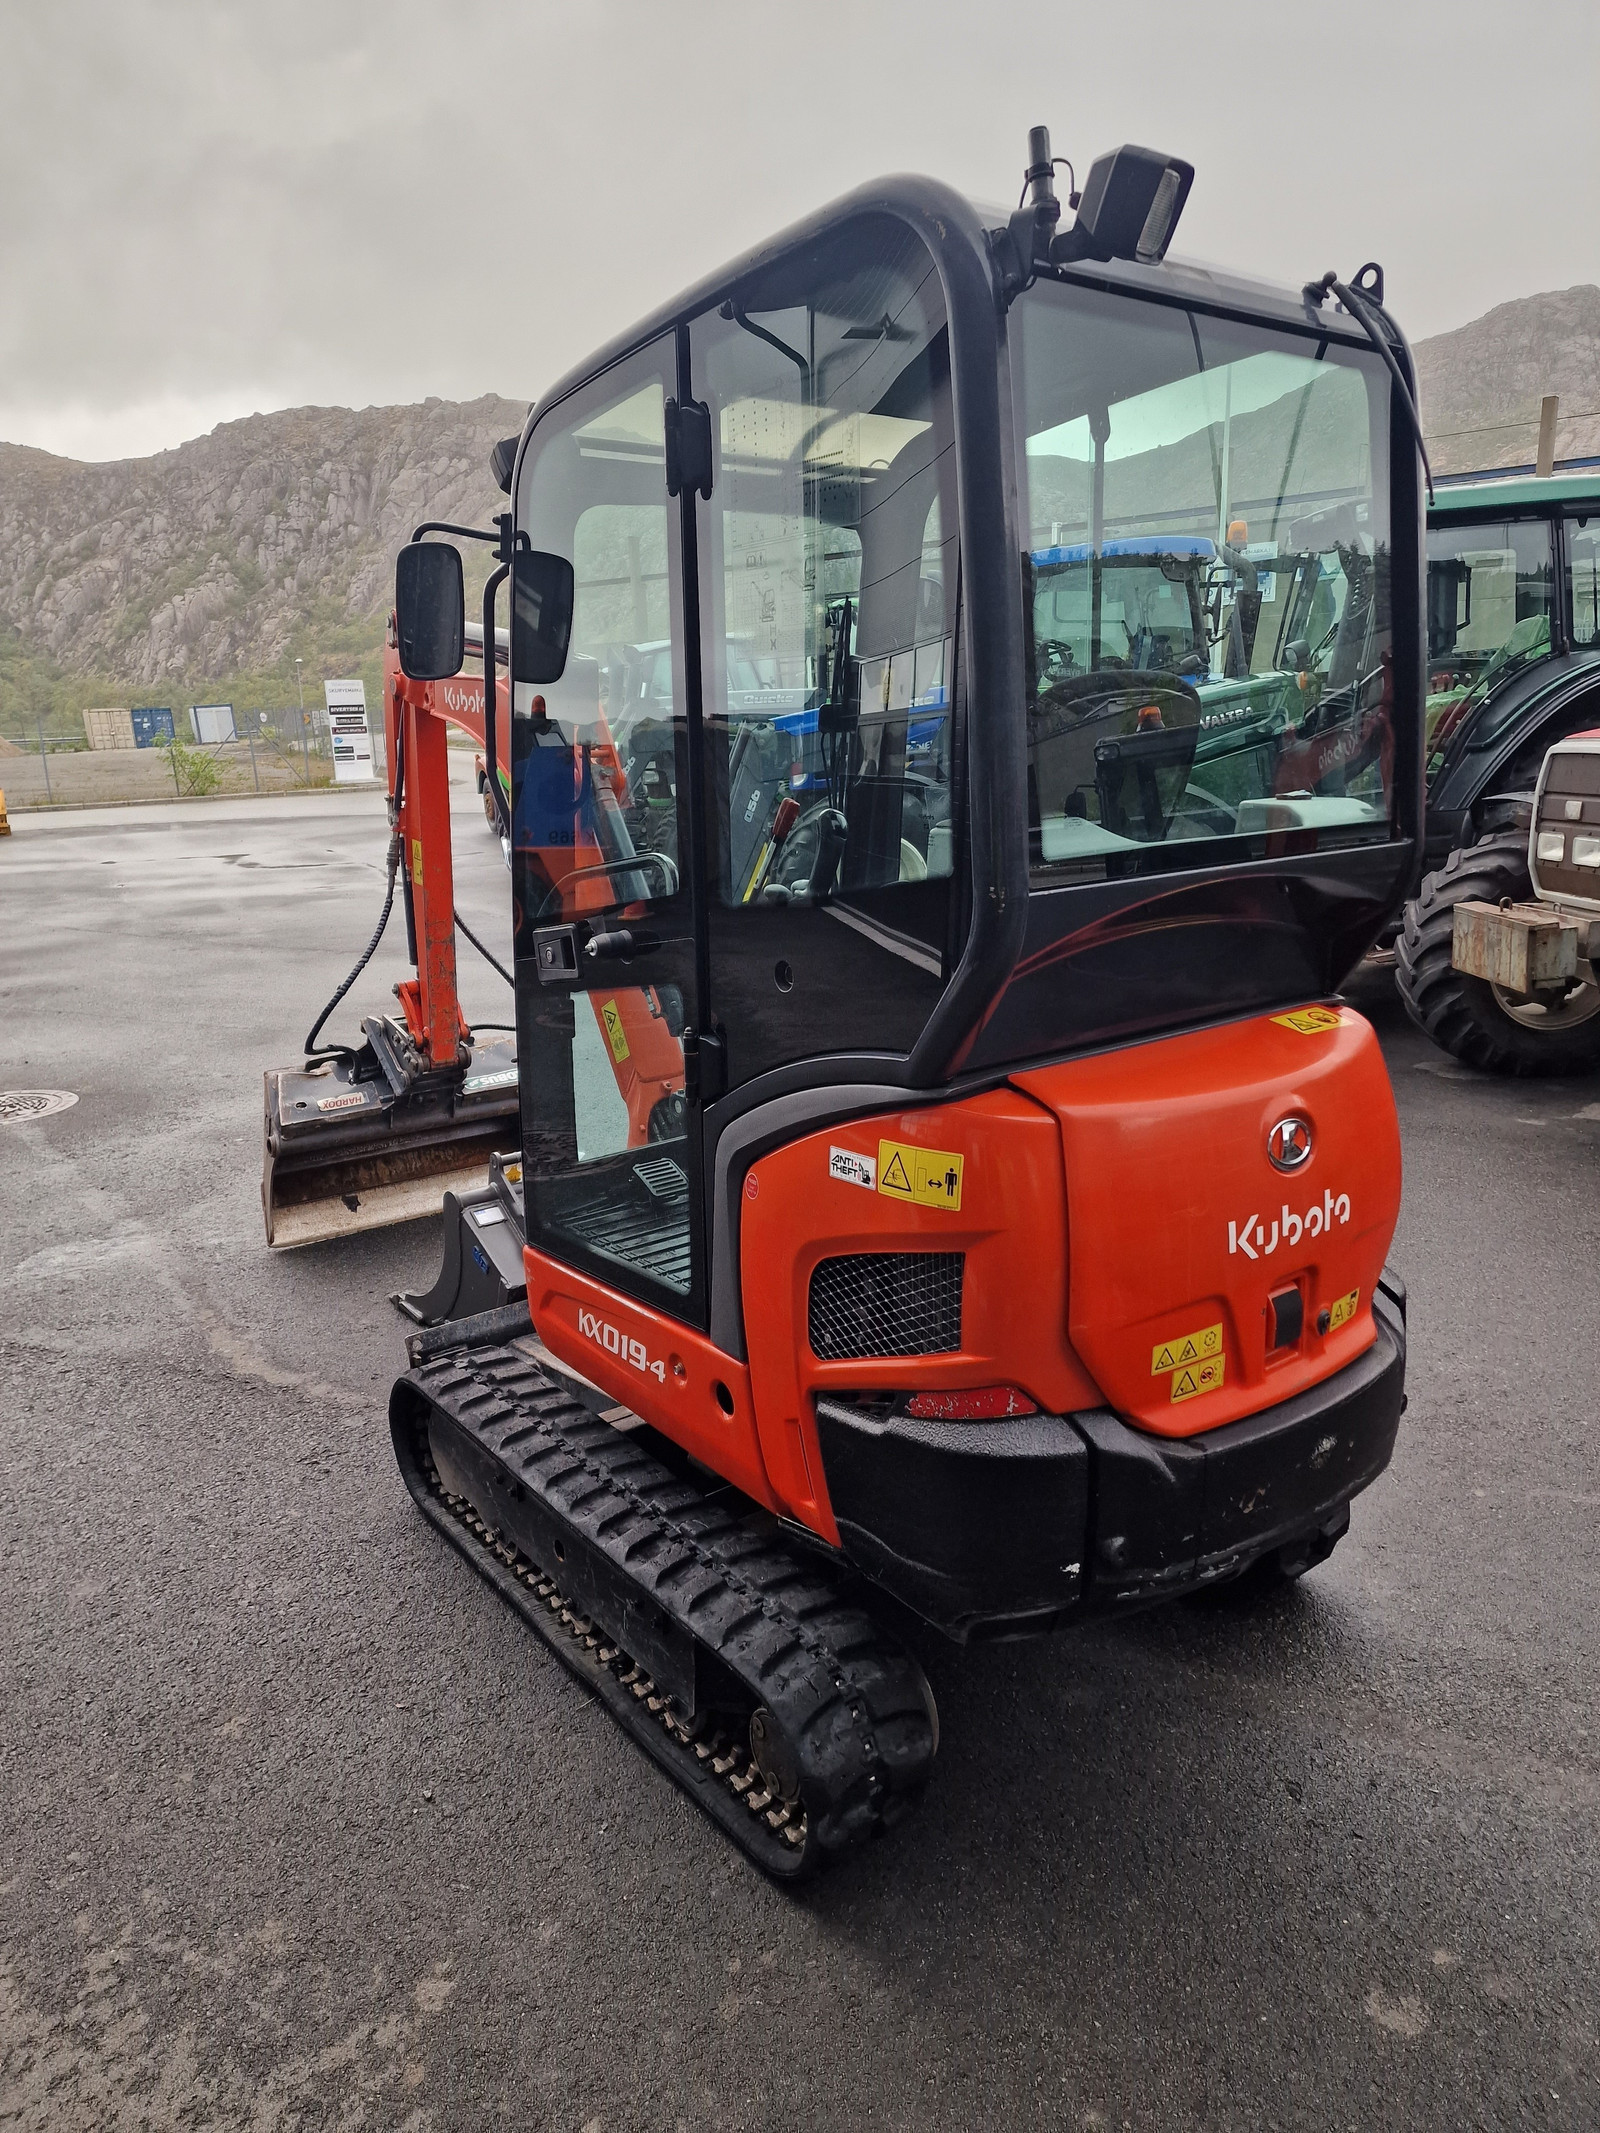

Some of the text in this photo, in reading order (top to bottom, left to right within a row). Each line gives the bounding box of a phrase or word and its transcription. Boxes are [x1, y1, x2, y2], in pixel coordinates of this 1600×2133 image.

[743, 694, 794, 704] Quicke
[1199, 706, 1254, 730] VALTRA
[323, 1096, 362, 1109] HARDOX
[831, 1154, 854, 1168] ANTI
[831, 1162, 858, 1178] THEFT
[1228, 1188, 1351, 1260] Kubota
[578, 1307, 667, 1384] KX019-4
